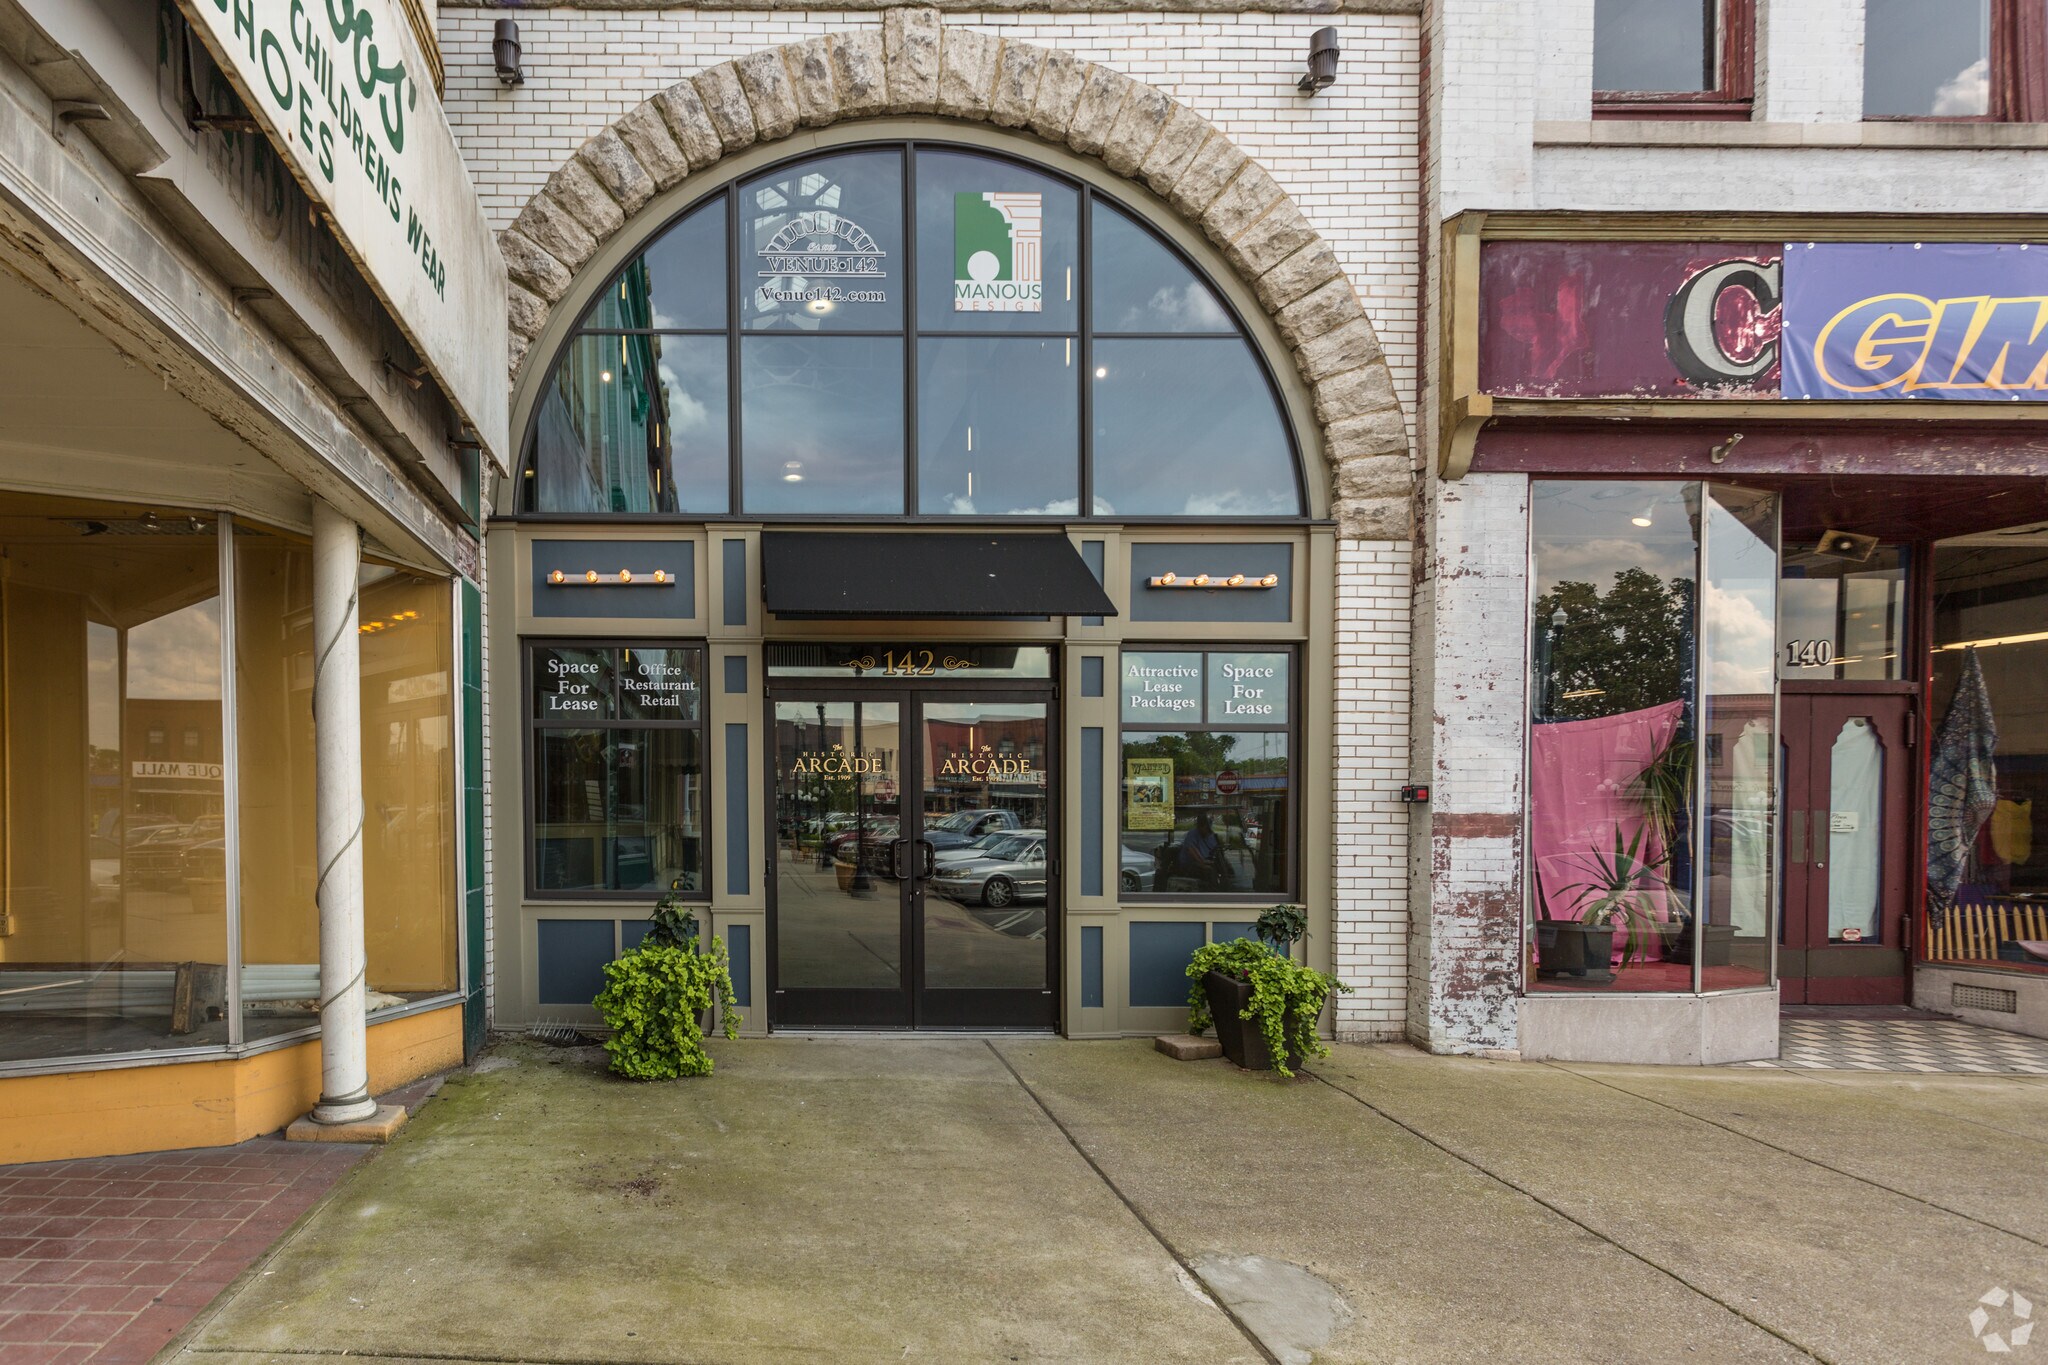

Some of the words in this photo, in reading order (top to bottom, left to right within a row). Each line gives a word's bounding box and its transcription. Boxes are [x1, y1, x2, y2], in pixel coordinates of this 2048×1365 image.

[214, 0, 334, 184] HOES
[290, 0, 402, 223] CHILDRENS
[407, 205, 445, 303] WEAR
[760, 286, 886, 303] Venue142.com
[955, 283, 1041, 299] MANOUS
[955, 301, 1041, 312] DESIGN
[1786, 639, 1832, 667] 140
[548, 659, 599, 677] Space
[638, 663, 681, 676] Office
[882, 650, 936, 676] 142
[1128, 665, 1199, 678] Attractive
[1223, 663, 1274, 682] Space
[558, 680, 589, 695] For
[624, 678, 695, 691] Restaurant
[1143, 681, 1182, 693] Lease
[1232, 684, 1264, 699] For
[550, 696, 598, 710] Lease
[640, 694, 679, 706] Retail
[1130, 696, 1196, 711] Packages
[1225, 700, 1273, 714] Lease
[792, 758, 883, 773] ARCADE
[941, 759, 1030, 774] ARCADE
[1131, 763, 1171, 774] WANTED
